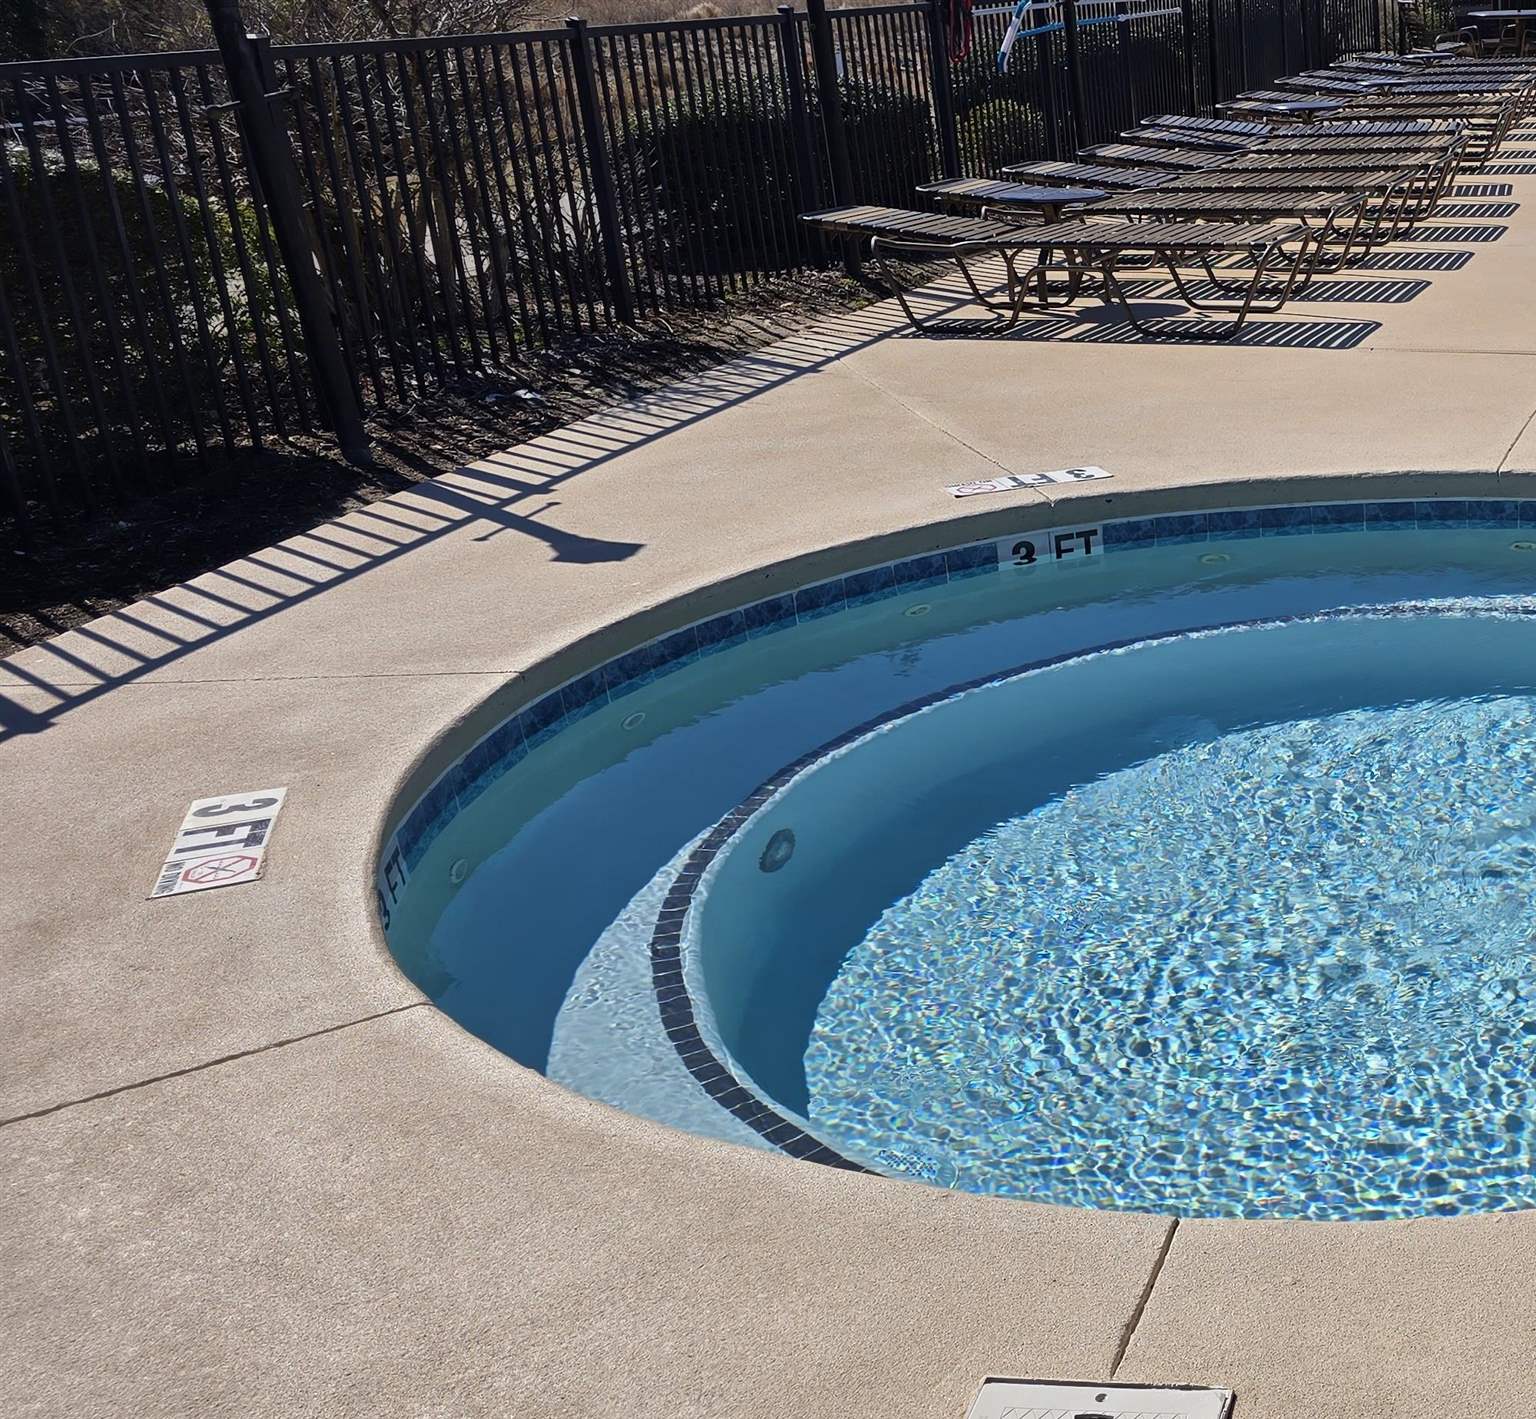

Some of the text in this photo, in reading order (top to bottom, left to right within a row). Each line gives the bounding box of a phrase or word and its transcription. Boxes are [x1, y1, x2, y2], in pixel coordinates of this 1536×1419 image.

[1007, 473, 1057, 488] FT
[1065, 468, 1096, 479] 3
[1012, 528, 1099, 566] 3 FT
[174, 797, 279, 855] 3 FT
[384, 845, 406, 905] FT
